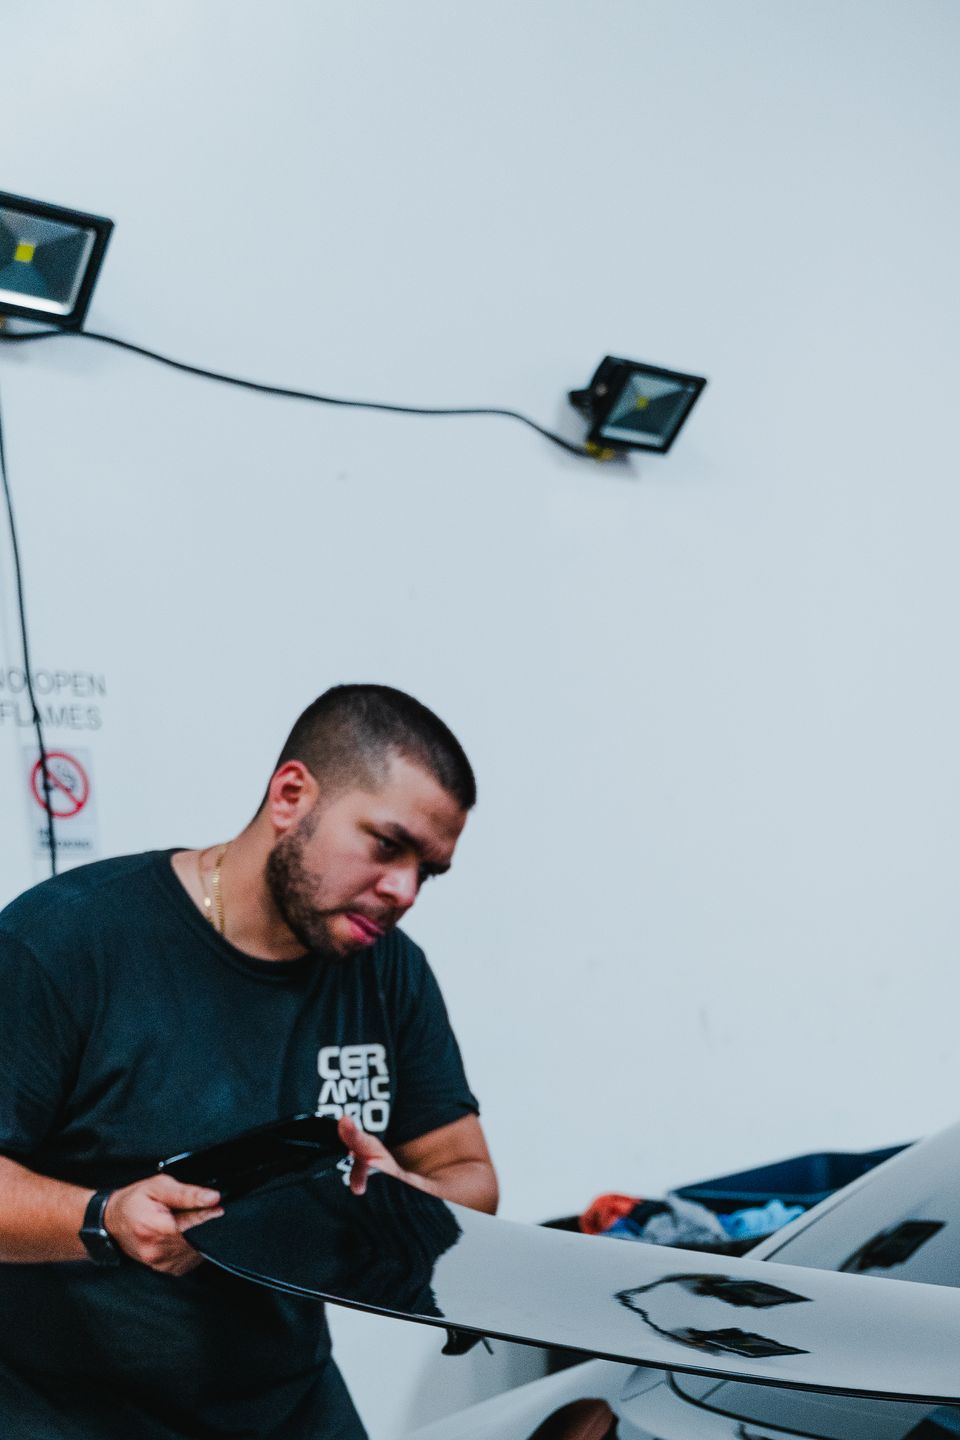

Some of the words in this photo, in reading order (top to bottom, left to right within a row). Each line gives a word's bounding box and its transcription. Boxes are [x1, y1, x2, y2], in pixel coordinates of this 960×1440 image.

[35, 668, 107, 697] OPEN
[0, 699, 104, 731] FLMES
[317, 1043, 389, 1080] CER
[318, 1076, 391, 1105] AMIC
